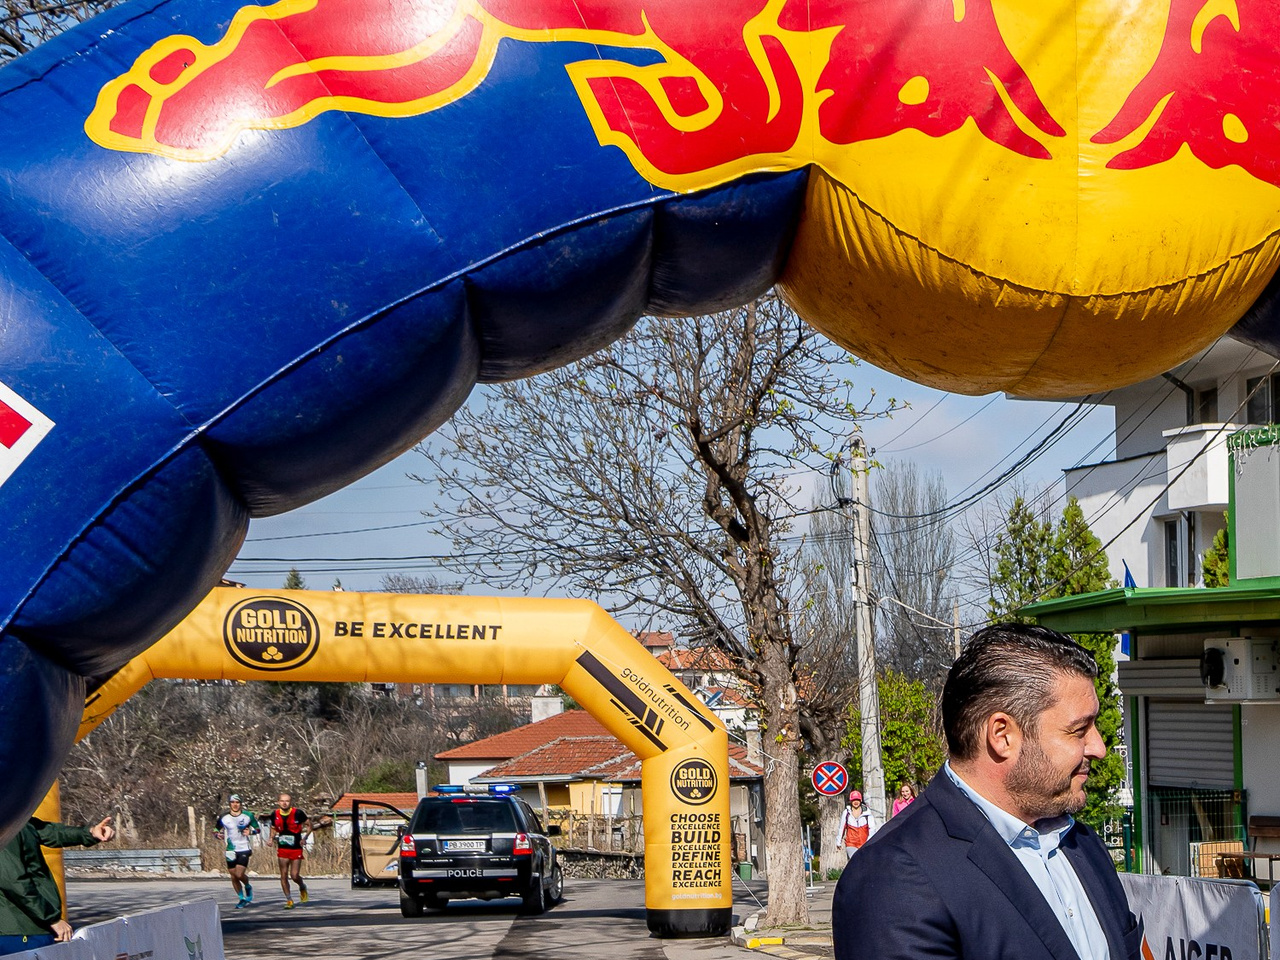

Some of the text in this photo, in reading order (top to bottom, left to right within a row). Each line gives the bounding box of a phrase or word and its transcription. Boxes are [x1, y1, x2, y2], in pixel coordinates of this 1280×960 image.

[240, 609, 303, 629] GOLD
[236, 628, 308, 645] NUTRITION
[334, 621, 502, 641] BE EXCELLENT
[620, 667, 691, 731] goldnutrition
[679, 767, 711, 779] GOLD
[676, 779, 713, 788] NUTRITION
[670, 813, 720, 823] CHOOSE
[671, 830, 721, 844] BUILD
[672, 851, 721, 862] DEFINE
[672, 861, 721, 869] EXCELLENCE
[447, 868, 483, 878] POLICE
[672, 869, 721, 881] REACH
[672, 880, 722, 888] EXCELLENCE
